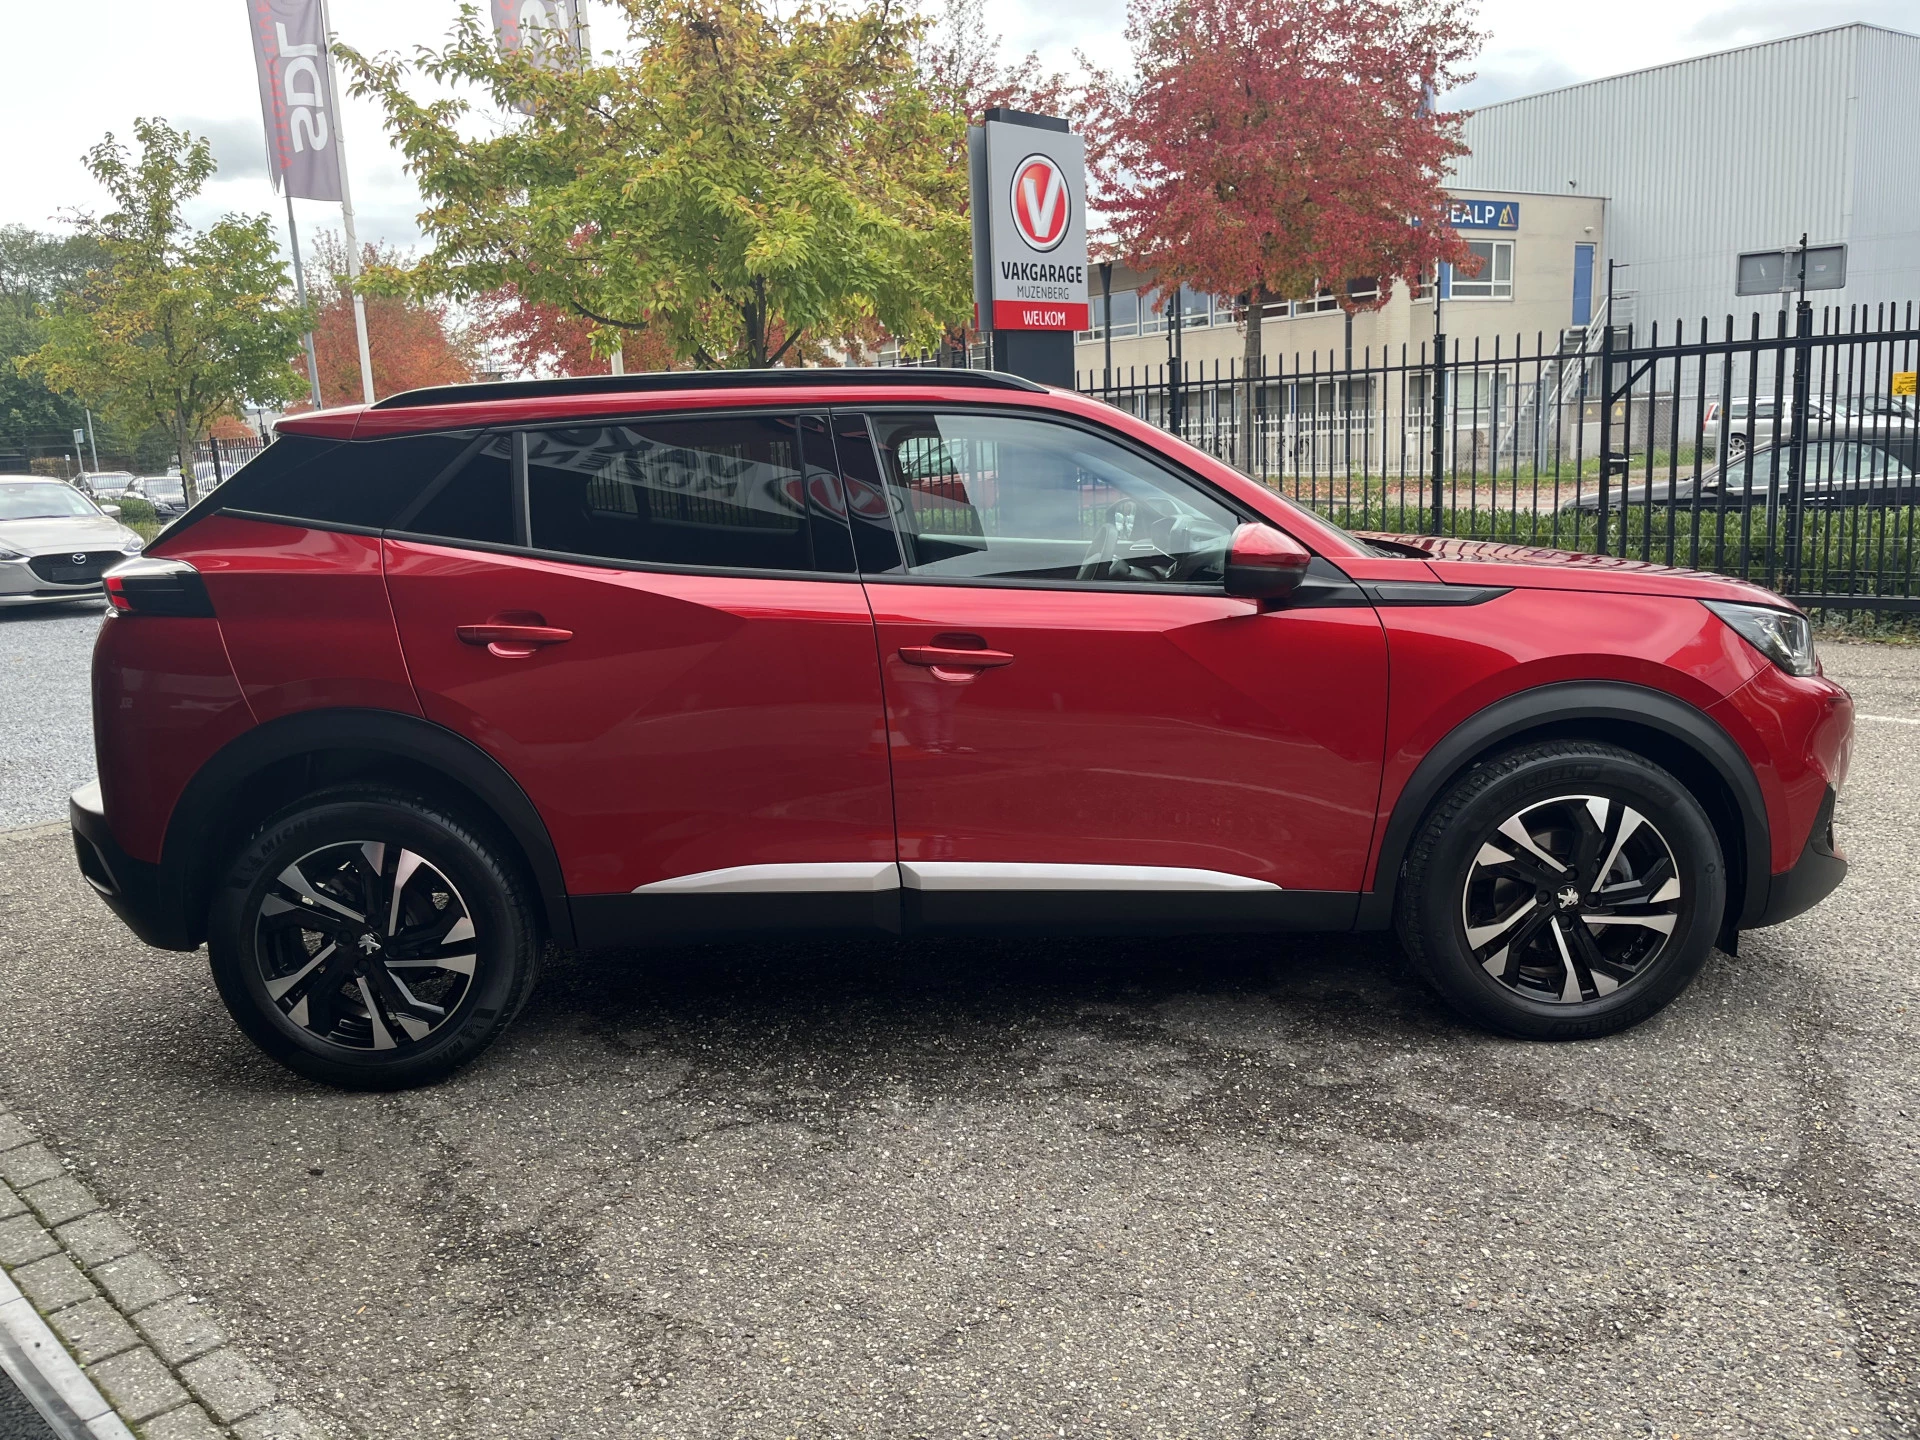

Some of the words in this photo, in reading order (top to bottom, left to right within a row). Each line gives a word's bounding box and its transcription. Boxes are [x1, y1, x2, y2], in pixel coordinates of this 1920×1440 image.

[1445, 203, 1496, 225] EALP
[1001, 261, 1083, 284] VAKGARAGE
[1016, 285, 1070, 301] MUZENBERG
[1022, 310, 1066, 326] WELKOM
